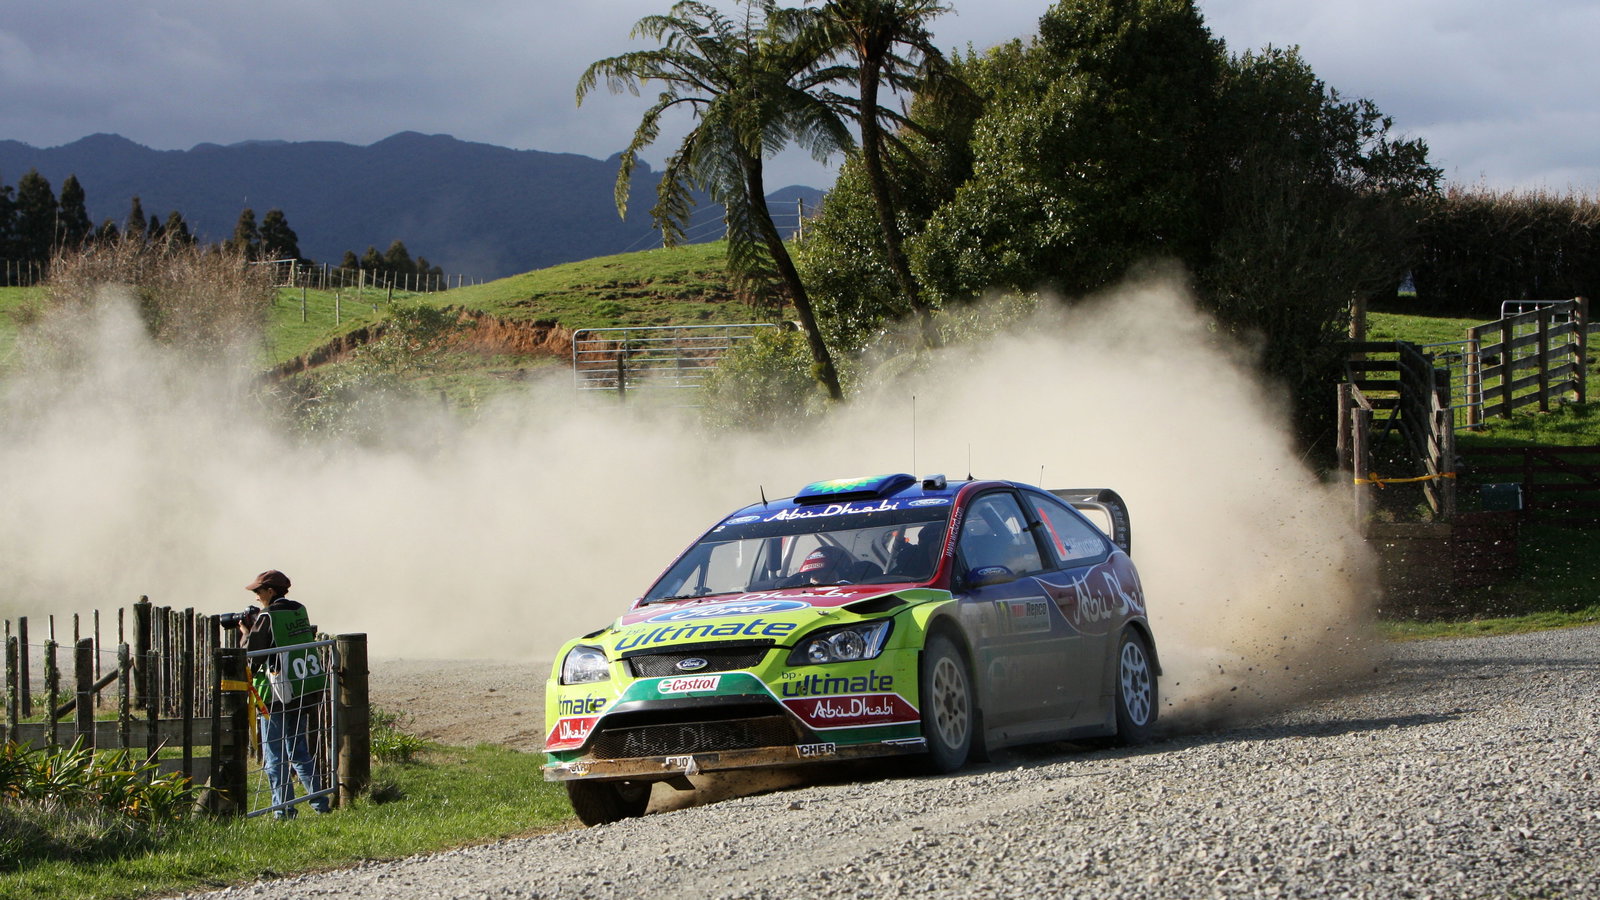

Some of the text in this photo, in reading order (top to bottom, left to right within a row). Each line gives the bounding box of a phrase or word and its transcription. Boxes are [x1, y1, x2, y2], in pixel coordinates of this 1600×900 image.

[763, 499, 900, 523] Abu Dhabi
[1072, 568, 1145, 625] Abu Dhab
[671, 602, 782, 620] Ford
[1025, 602, 1048, 620] Repco
[614, 618, 798, 651] ultimate
[293, 654, 320, 679] 03
[781, 671, 796, 680] bp
[672, 677, 716, 691] Castrol
[782, 669, 893, 697] ultimate
[810, 697, 894, 719] Abu Dhabi
[798, 743, 834, 755] CHER
